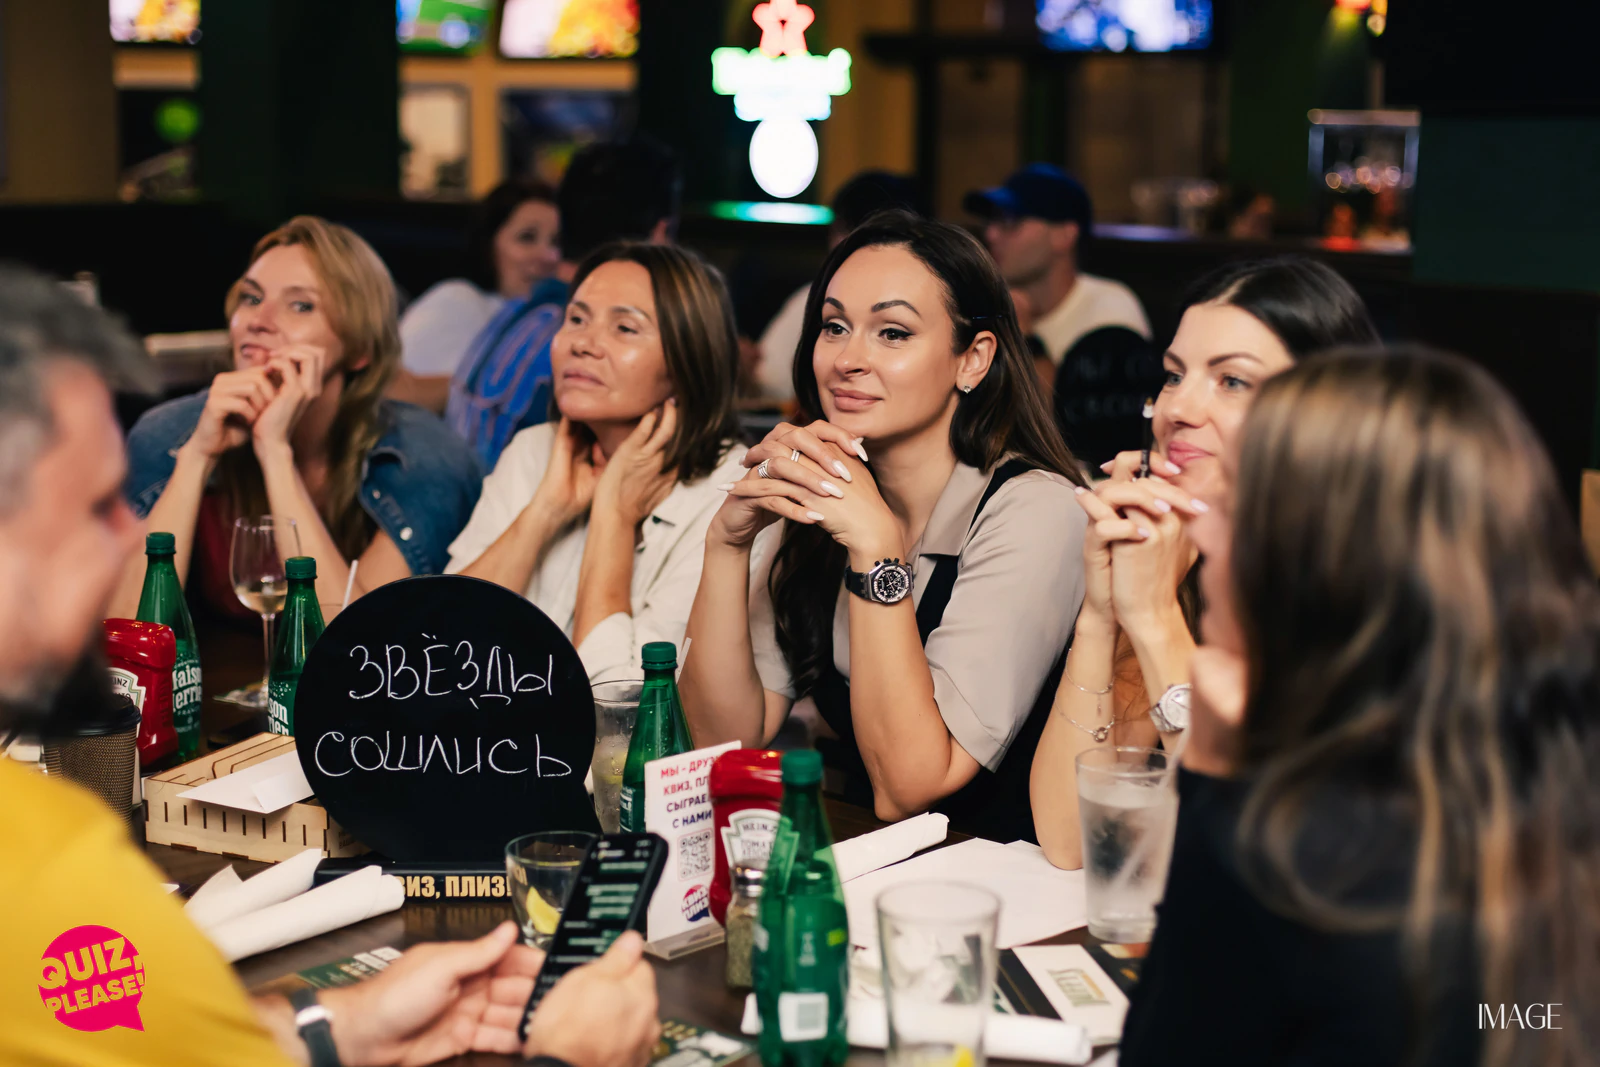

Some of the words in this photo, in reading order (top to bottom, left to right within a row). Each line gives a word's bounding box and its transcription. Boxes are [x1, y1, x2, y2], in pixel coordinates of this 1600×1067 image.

[348, 632, 553, 709] ЗВЁЗДЫ
[660, 765, 679, 778] МЫ
[663, 780, 693, 796] КВИЗ,
[666, 793, 708, 812] СЫГРАЕ
[672, 818, 679, 829] С
[681, 809, 712, 826] НАМИ
[445, 876, 512, 898] ПЛИЗ!
